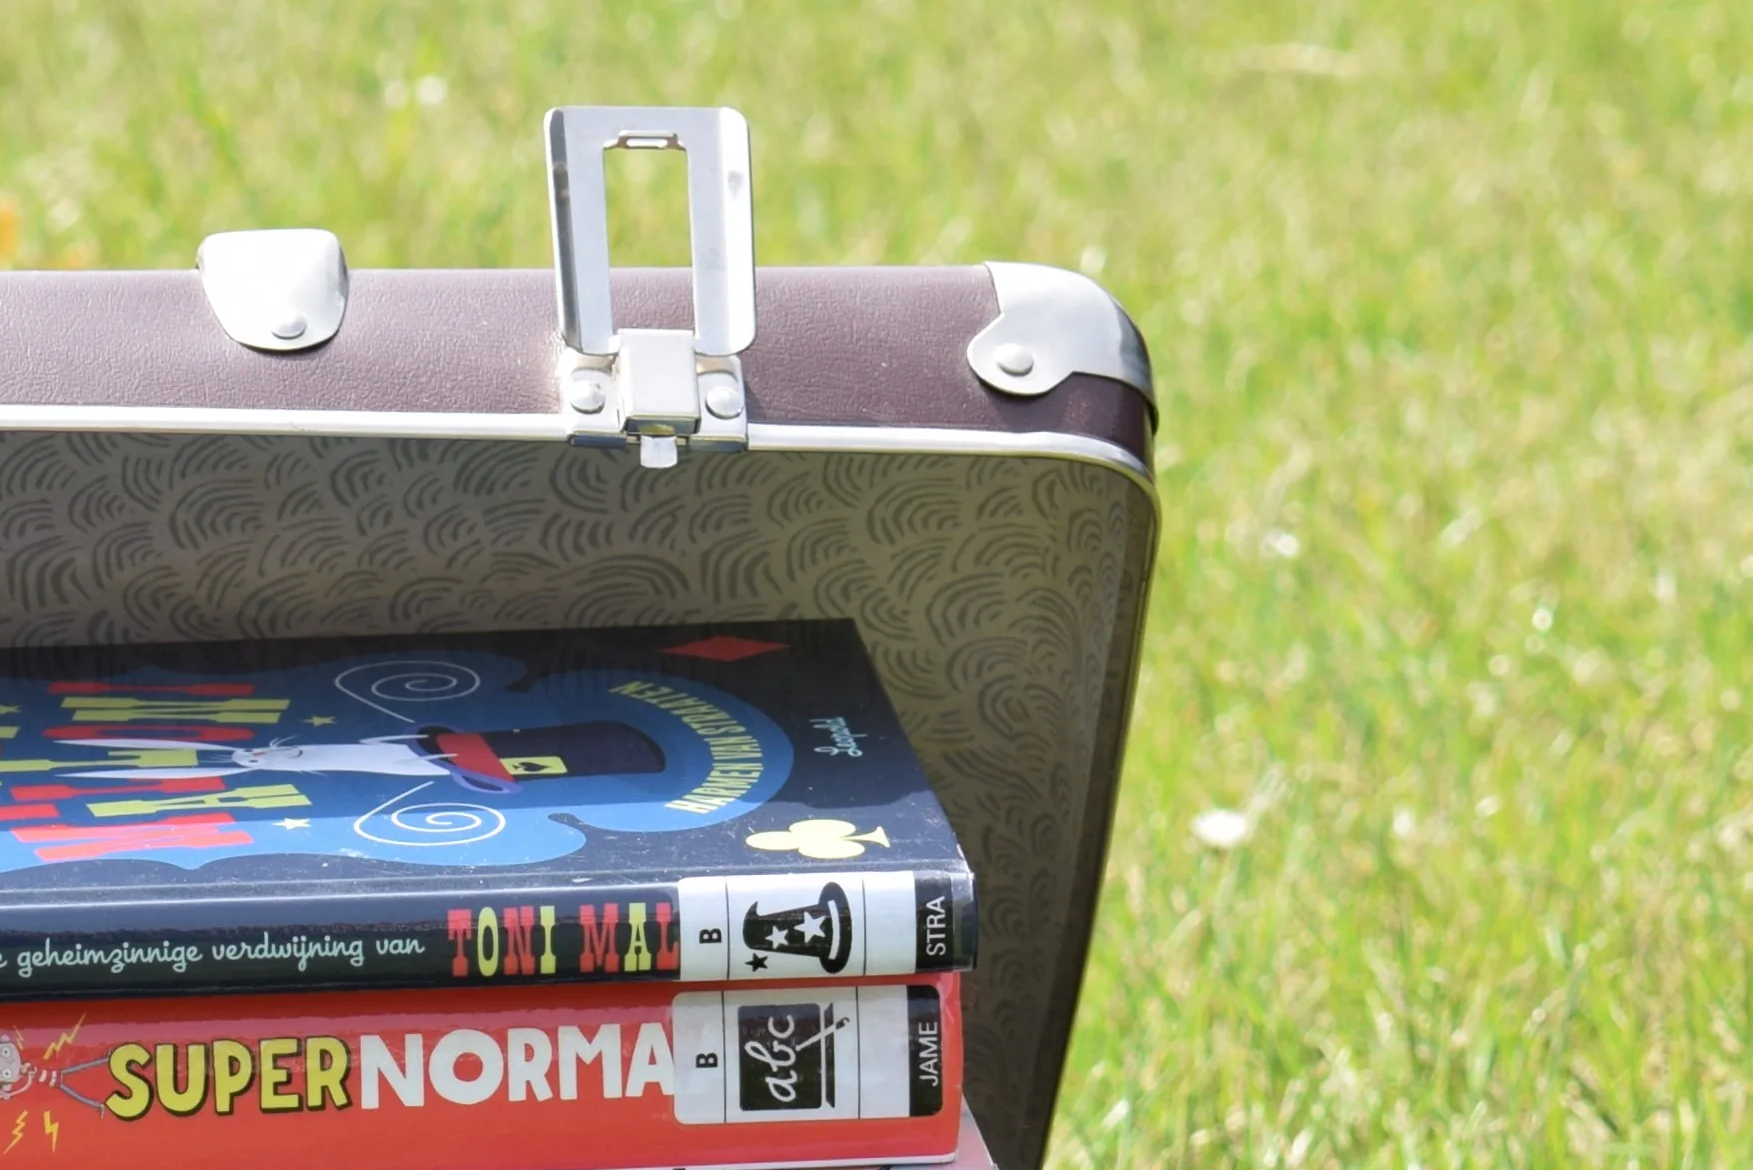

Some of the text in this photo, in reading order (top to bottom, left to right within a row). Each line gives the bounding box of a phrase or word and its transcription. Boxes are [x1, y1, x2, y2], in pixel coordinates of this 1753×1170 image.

[608, 680, 763, 814] HARMEN VAN STRAATEN
[17, 938, 203, 978] geheimzinnige
[212, 931, 365, 972] verdwijning
[376, 937, 426, 957] van
[448, 904, 556, 977] TONI
[579, 902, 681, 973] MAL
[699, 927, 722, 944] B
[926, 896, 945, 956] STRA
[695, 1052, 718, 1068] B
[744, 1014, 798, 1103] abc
[918, 1021, 938, 1087] JAME
